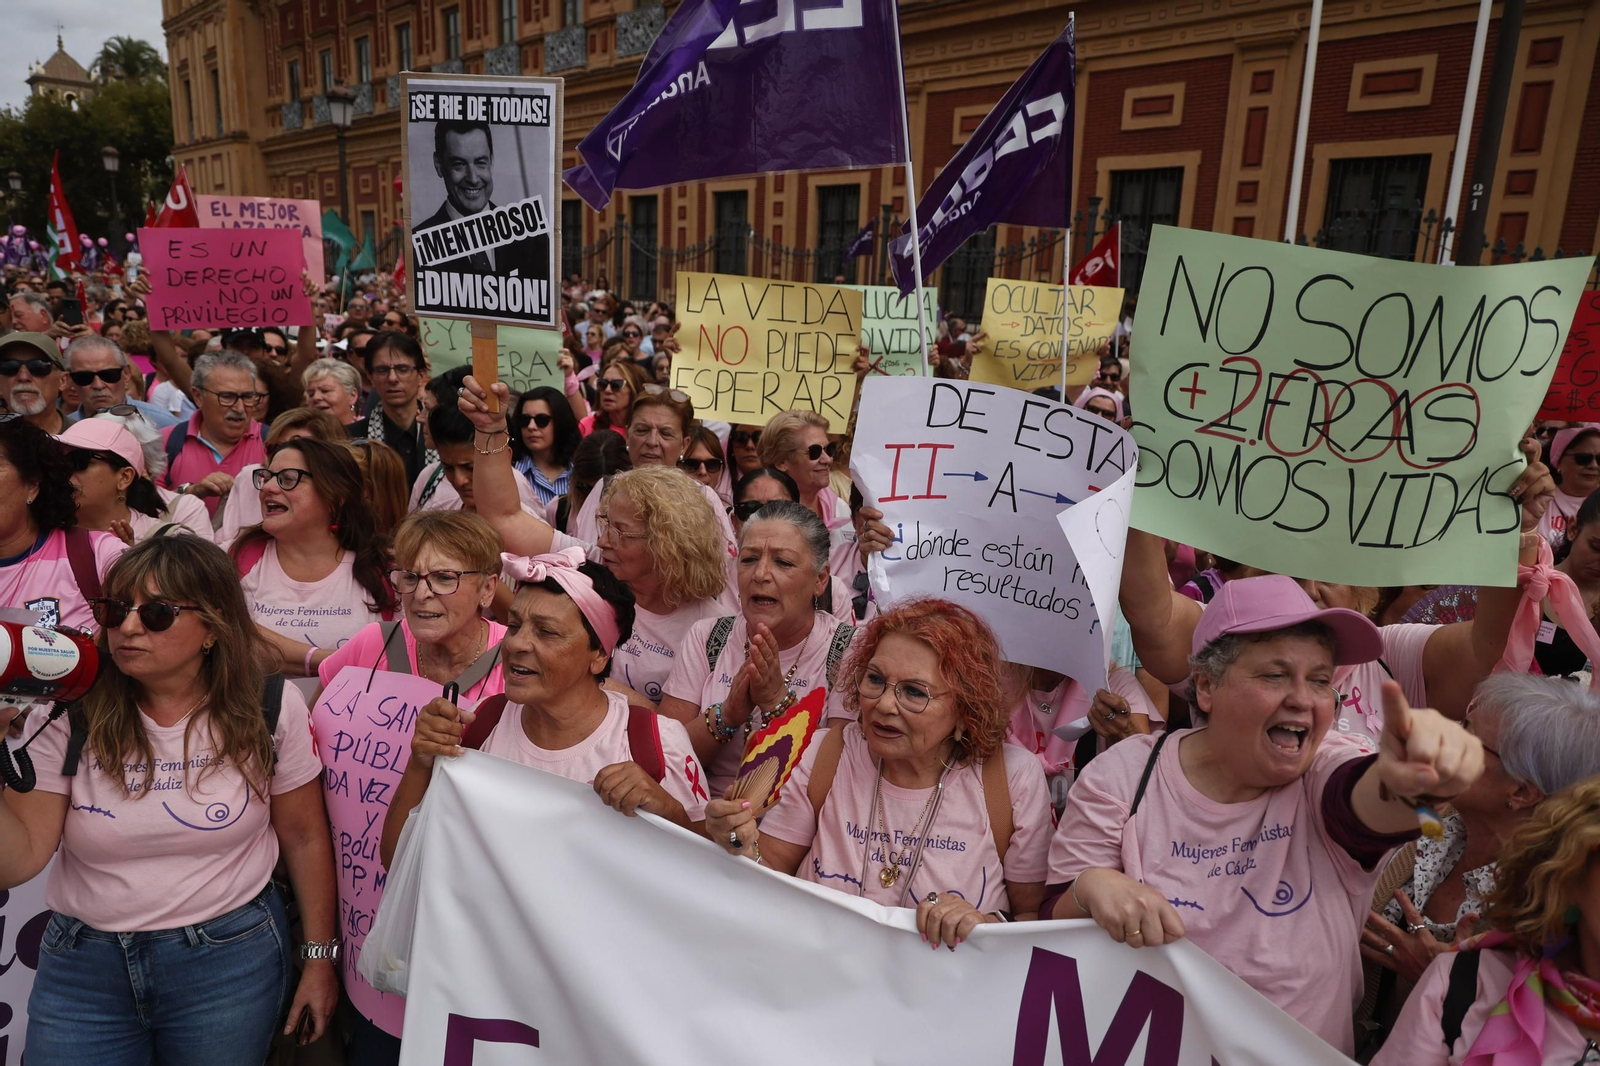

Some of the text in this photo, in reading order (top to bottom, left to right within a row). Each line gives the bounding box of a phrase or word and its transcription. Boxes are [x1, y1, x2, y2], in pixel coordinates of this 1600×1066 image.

[411, 94, 548, 124] ¡SE RIE DE TODAS!
[210, 201, 300, 221] EL MEJOR
[415, 199, 547, 266] ¡MENTIROSO!
[168, 240, 267, 259] ES UN
[167, 266, 286, 287] DERECHO
[417, 268, 548, 315] ¡DIMISIÓN!
[219, 285, 293, 305] NO UN
[686, 277, 853, 331] LA VIDA
[991, 283, 1096, 316] OCULTAR
[1020, 316, 1084, 337] DATOS
[1160, 255, 1562, 383] NO SOMOS
[697, 324, 856, 374] NO PUEDE
[993, 340, 1021, 359] ES
[1012, 362, 1077, 381] VIDAS
[676, 368, 845, 420] ESPERAR
[926, 383, 1137, 474] DE ESTA
[1163, 362, 1480, 462] CIFRAS
[987, 461, 1017, 513] A
[1131, 421, 1524, 549] SOMOS VIDAS
[982, 534, 1053, 575] están
[253, 602, 352, 616] Mujeres Feministas
[943, 566, 1081, 620] resultados
[275, 618, 319, 627] de Cádiz
[322, 678, 362, 722] LA
[328, 730, 404, 775] PÚBL
[321, 765, 391, 807] ADA VEZ
[361, 811, 379, 838] Y
[893, 829, 966, 852] Femnistas
[871, 847, 885, 863] de
[1171, 841, 1228, 865] Mujeres
[1207, 862, 1221, 878] de
